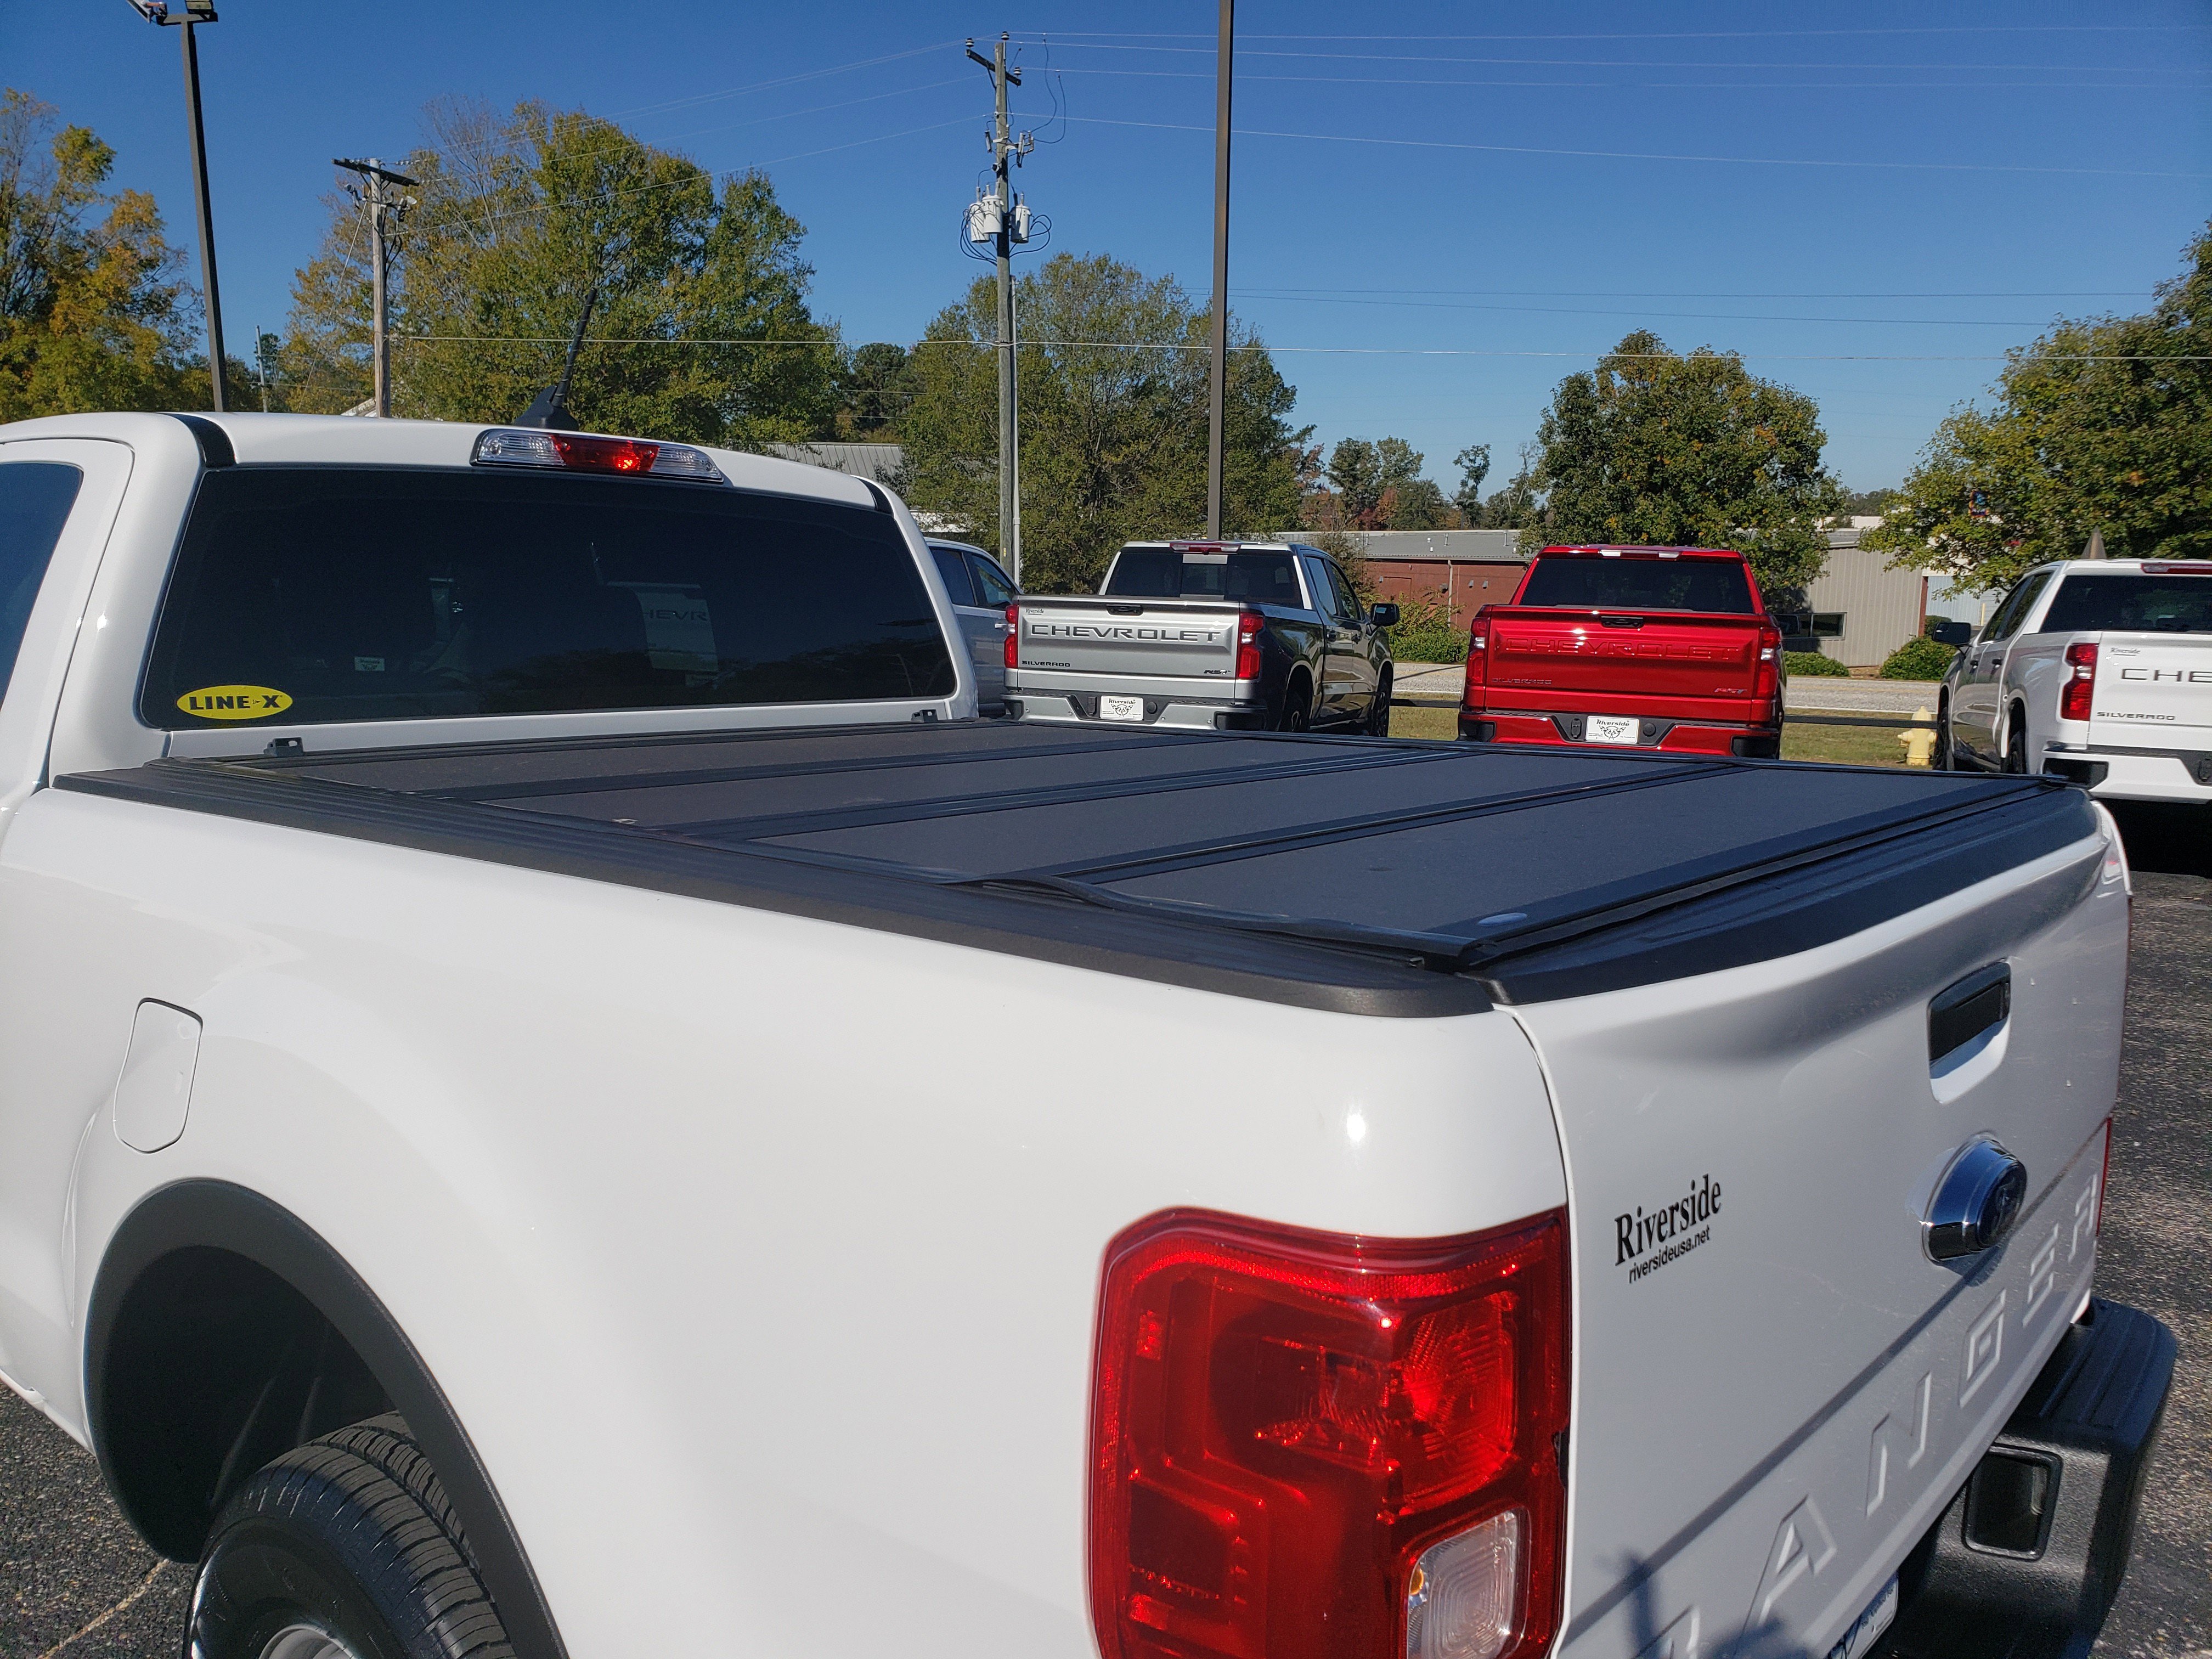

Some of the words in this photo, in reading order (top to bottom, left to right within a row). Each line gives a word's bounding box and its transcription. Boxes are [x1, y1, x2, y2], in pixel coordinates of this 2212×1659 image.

[1031, 624, 1221, 642] CHEVROLET
[1506, 638, 1739, 659] CHEVROLET
[2097, 712, 2175, 720] SILVERADO
[1615, 1173, 1722, 1266] Riverside
[1629, 1224, 1711, 1283] riversideusa.net
